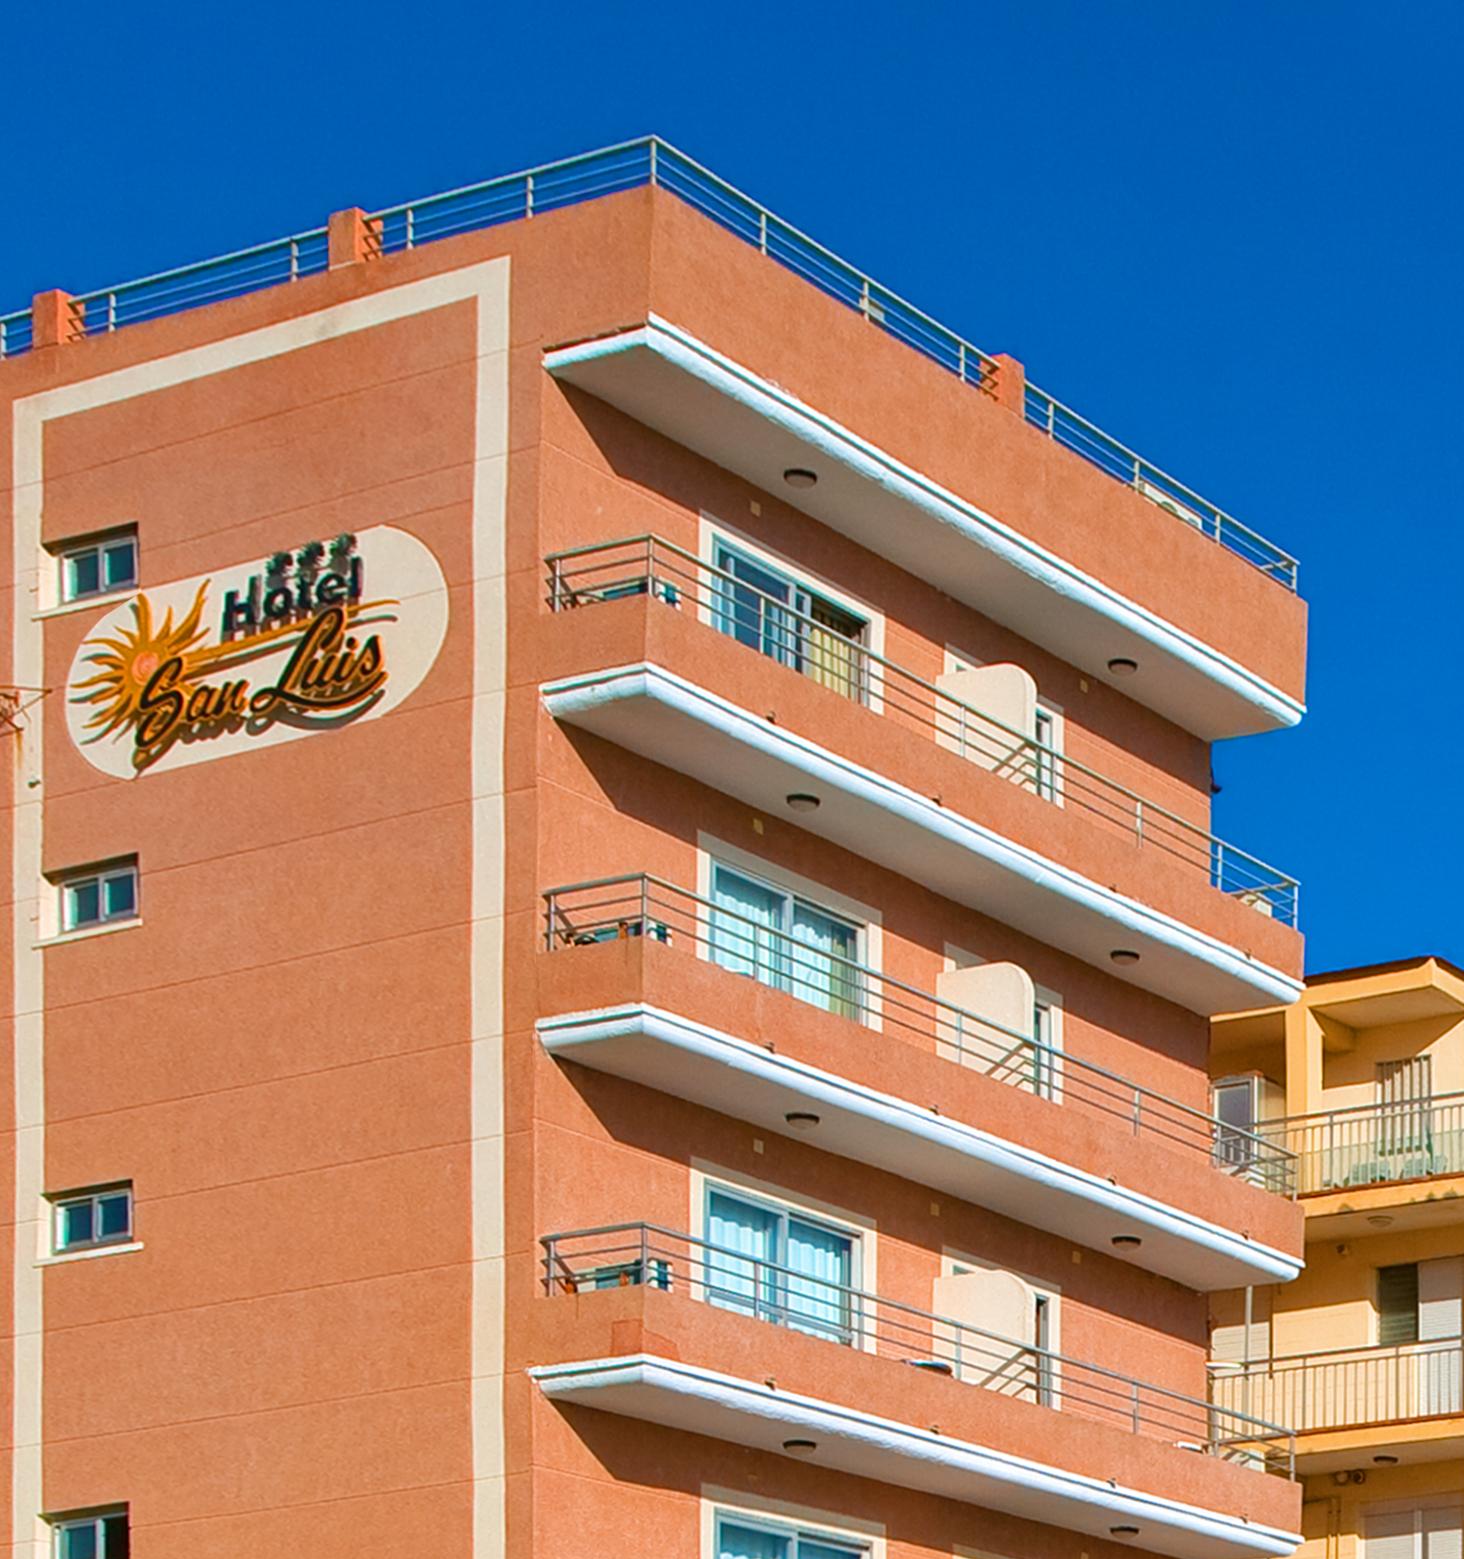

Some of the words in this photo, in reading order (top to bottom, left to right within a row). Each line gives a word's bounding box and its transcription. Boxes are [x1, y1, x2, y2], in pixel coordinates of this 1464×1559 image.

[221, 557, 365, 637] Hotel
[135, 658, 248, 750] San
[249, 606, 388, 714] Luis
